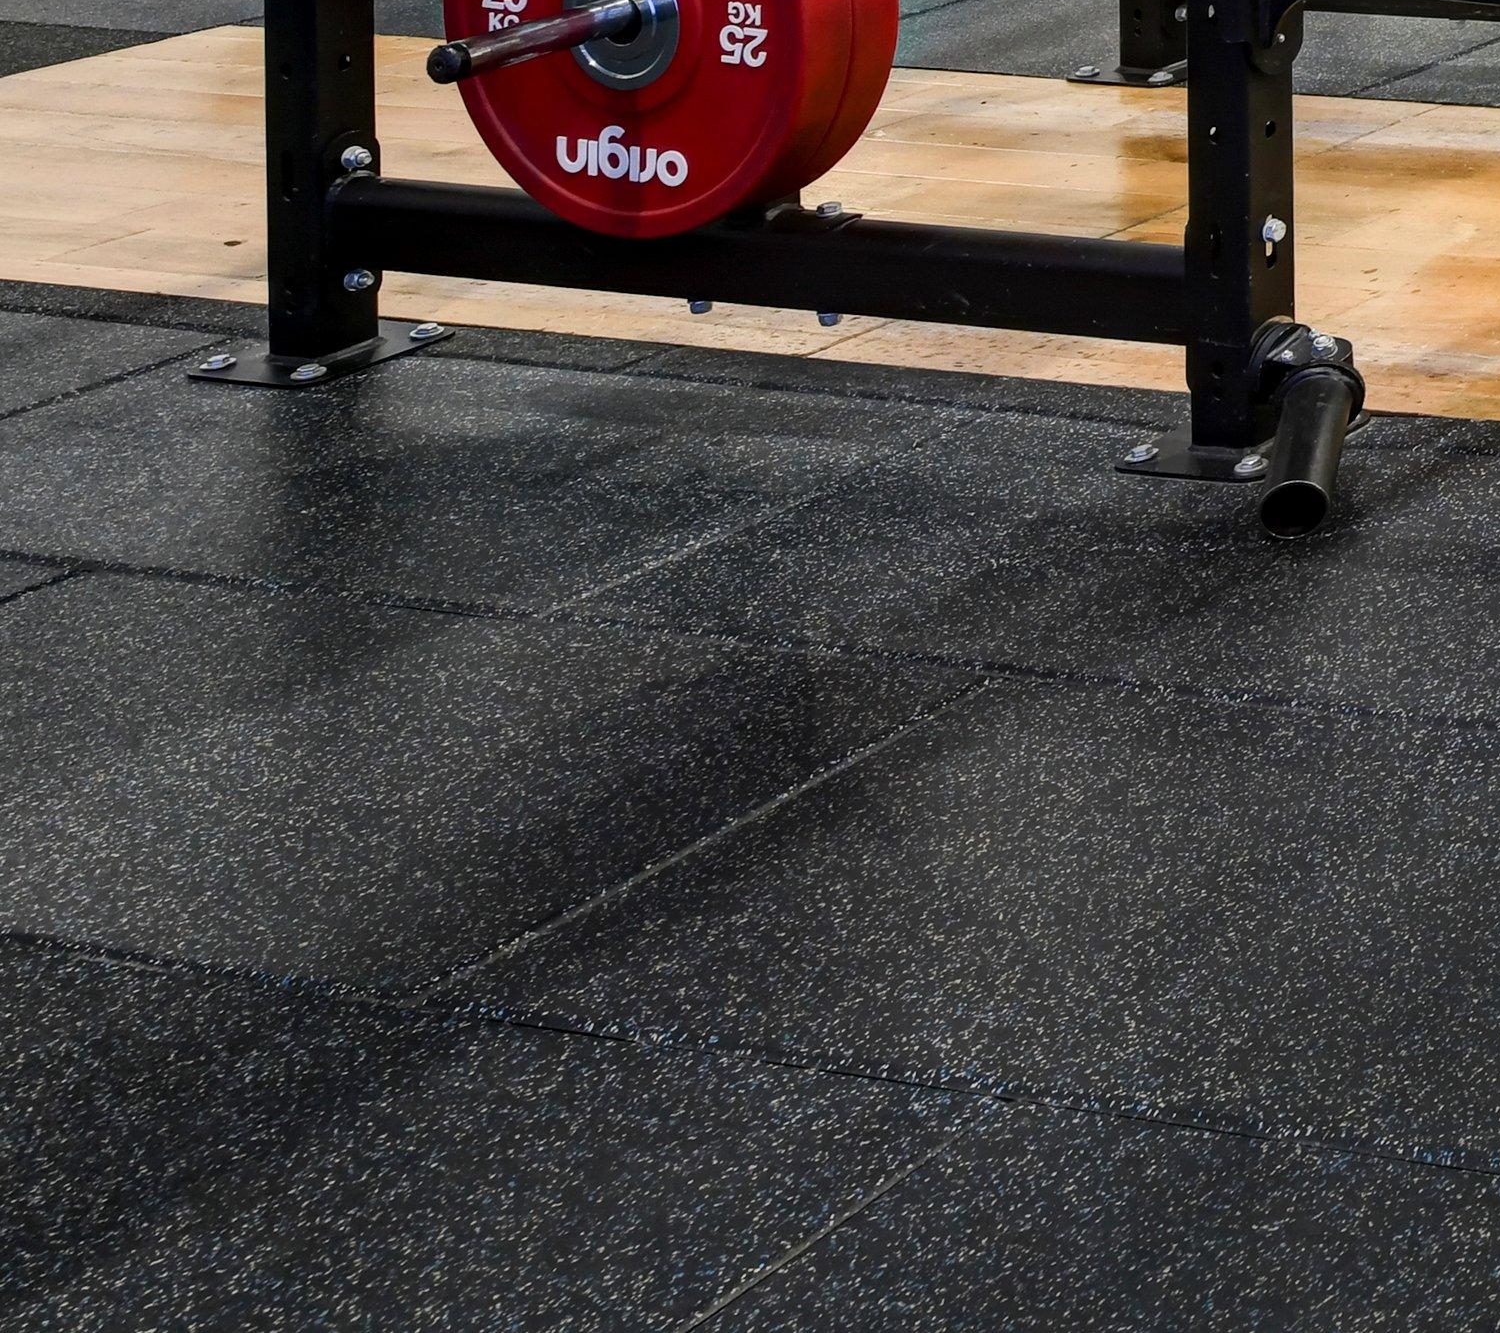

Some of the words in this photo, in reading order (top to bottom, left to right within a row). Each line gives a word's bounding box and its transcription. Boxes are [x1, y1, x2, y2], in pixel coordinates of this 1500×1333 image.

[727, 1, 761, 26] KG
[719, 26, 768, 68] 25
[556, 125, 688, 187] origin
